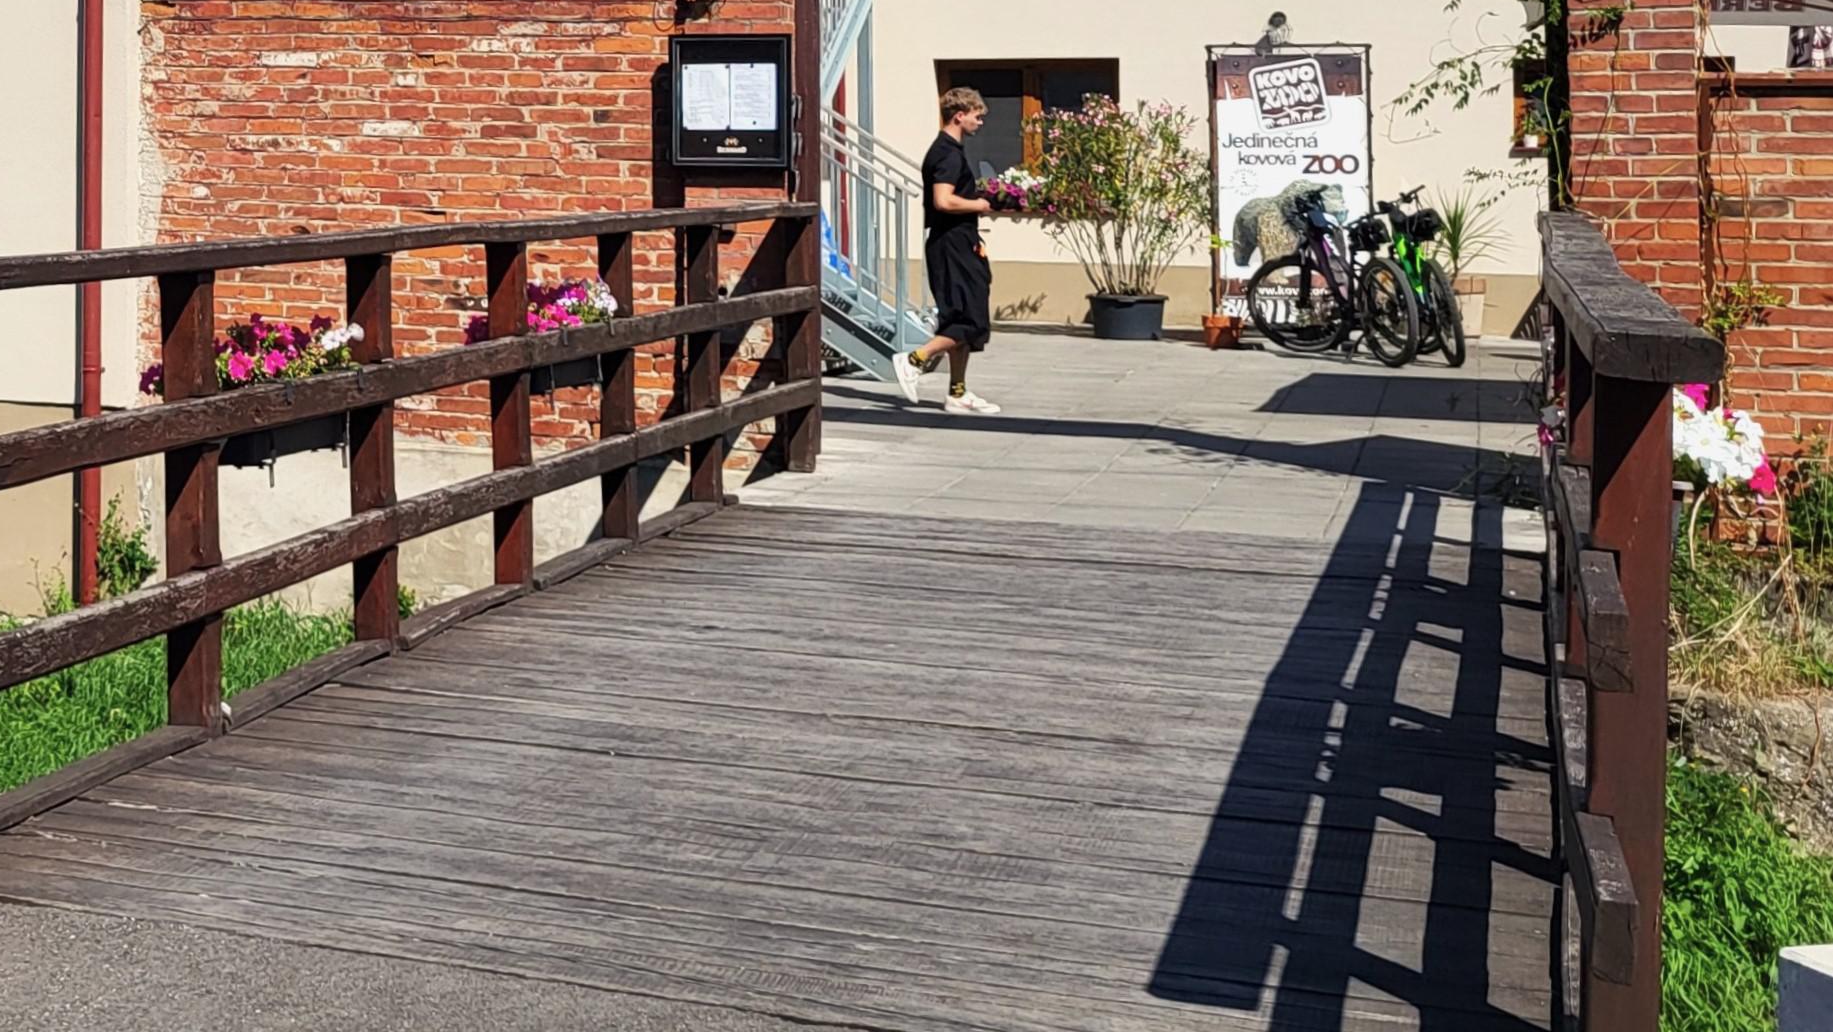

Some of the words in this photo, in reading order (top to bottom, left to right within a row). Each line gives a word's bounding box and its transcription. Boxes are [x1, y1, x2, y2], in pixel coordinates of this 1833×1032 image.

[1254, 65, 1315, 89] KOVO
[1259, 82, 1320, 110] ZOO
[1222, 131, 1318, 148] Jedinečná
[1238, 150, 1297, 165] kovová
